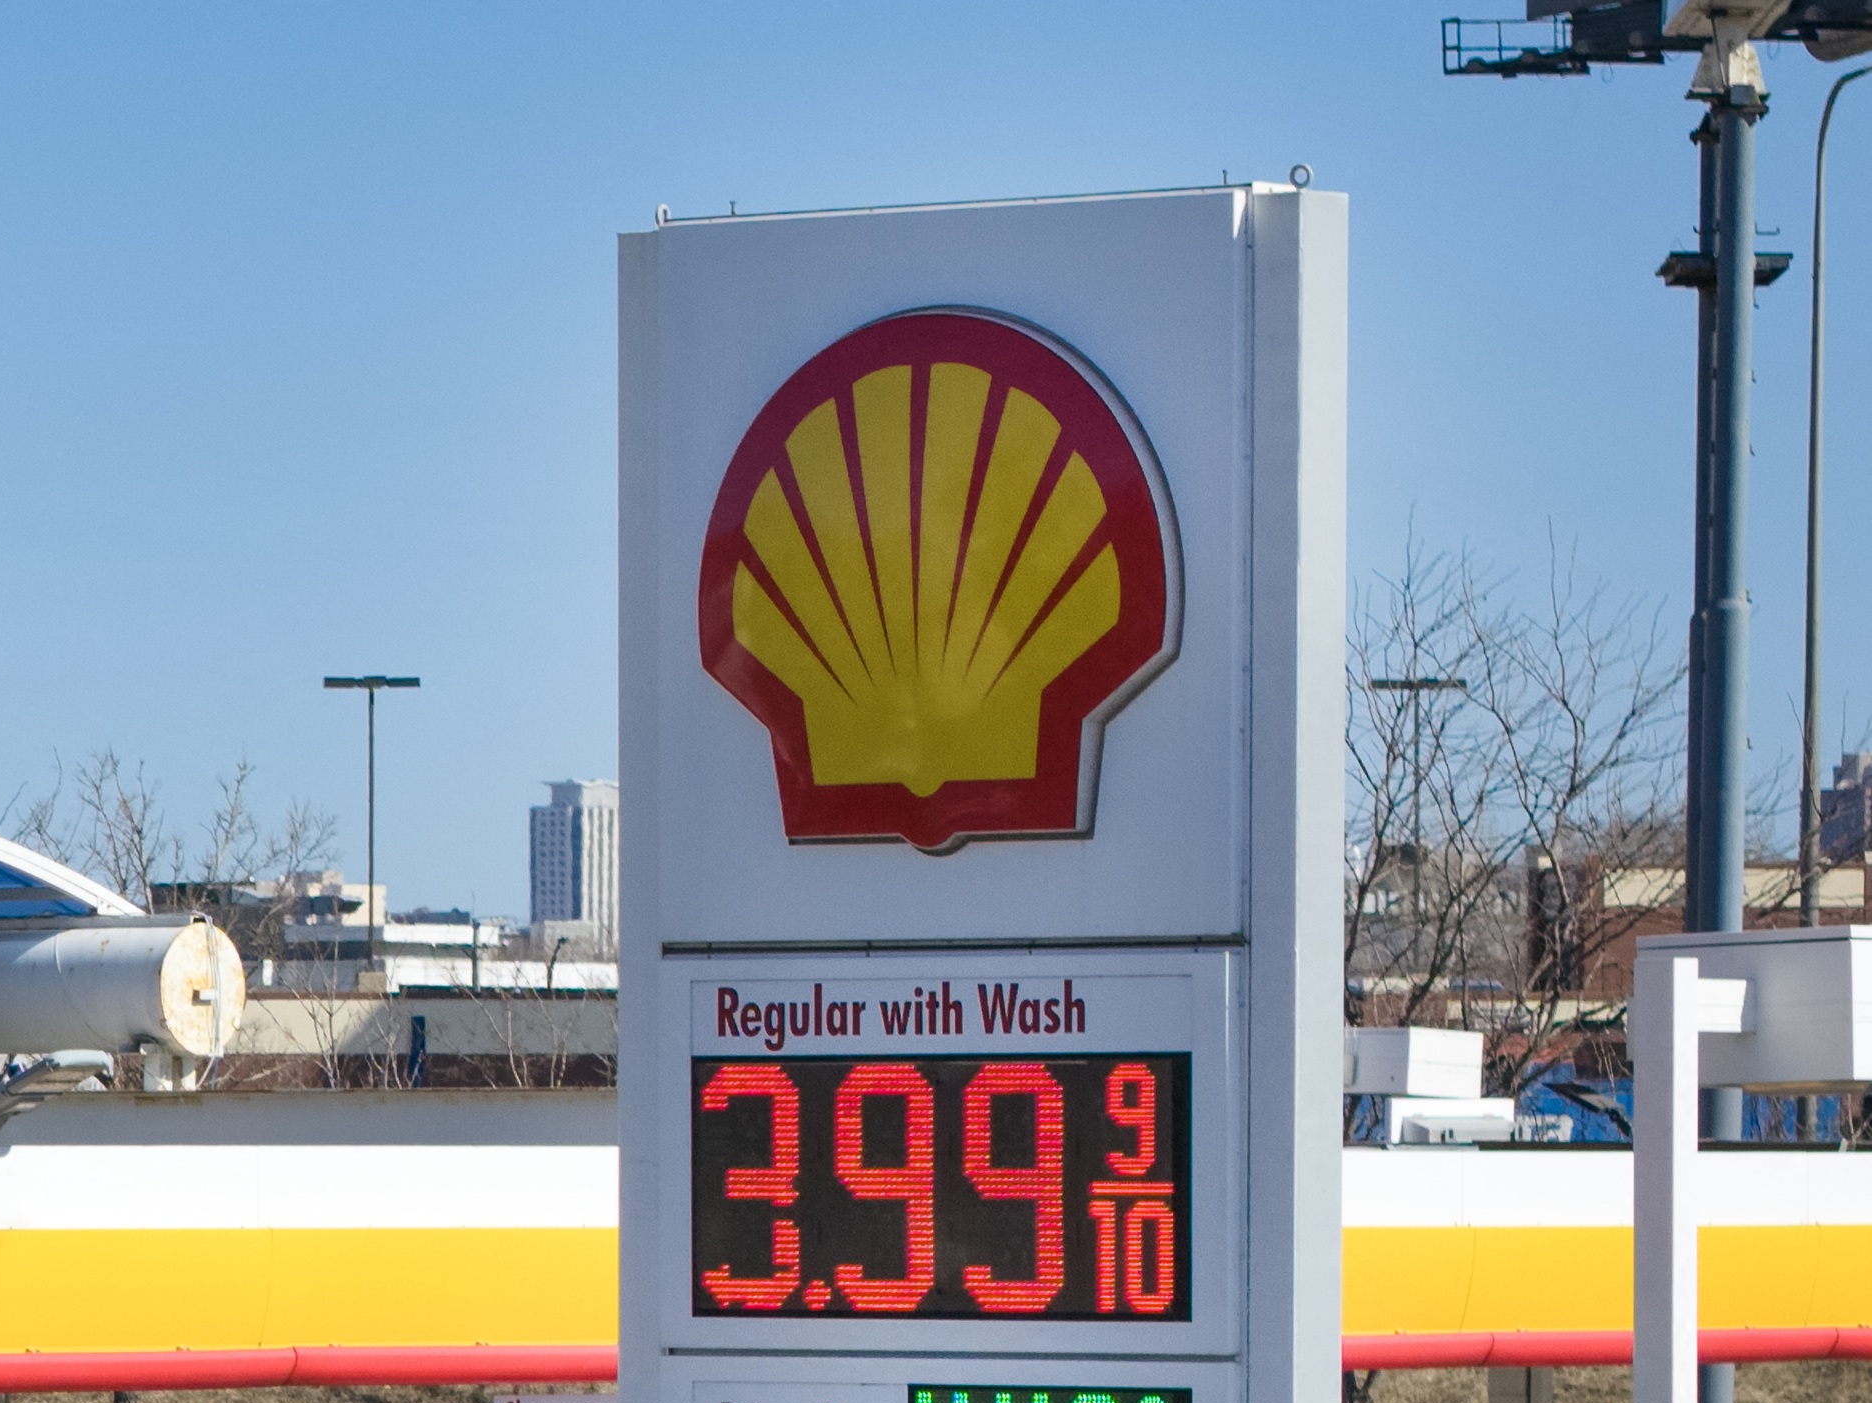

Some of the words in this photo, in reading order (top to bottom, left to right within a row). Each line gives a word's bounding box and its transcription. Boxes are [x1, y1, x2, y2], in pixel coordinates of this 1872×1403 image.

[717, 987, 866, 1051] Regular
[879, 982, 964, 1036] with
[978, 981, 1086, 1034] Wash
[702, 1062, 1063, 1311] 3.99
